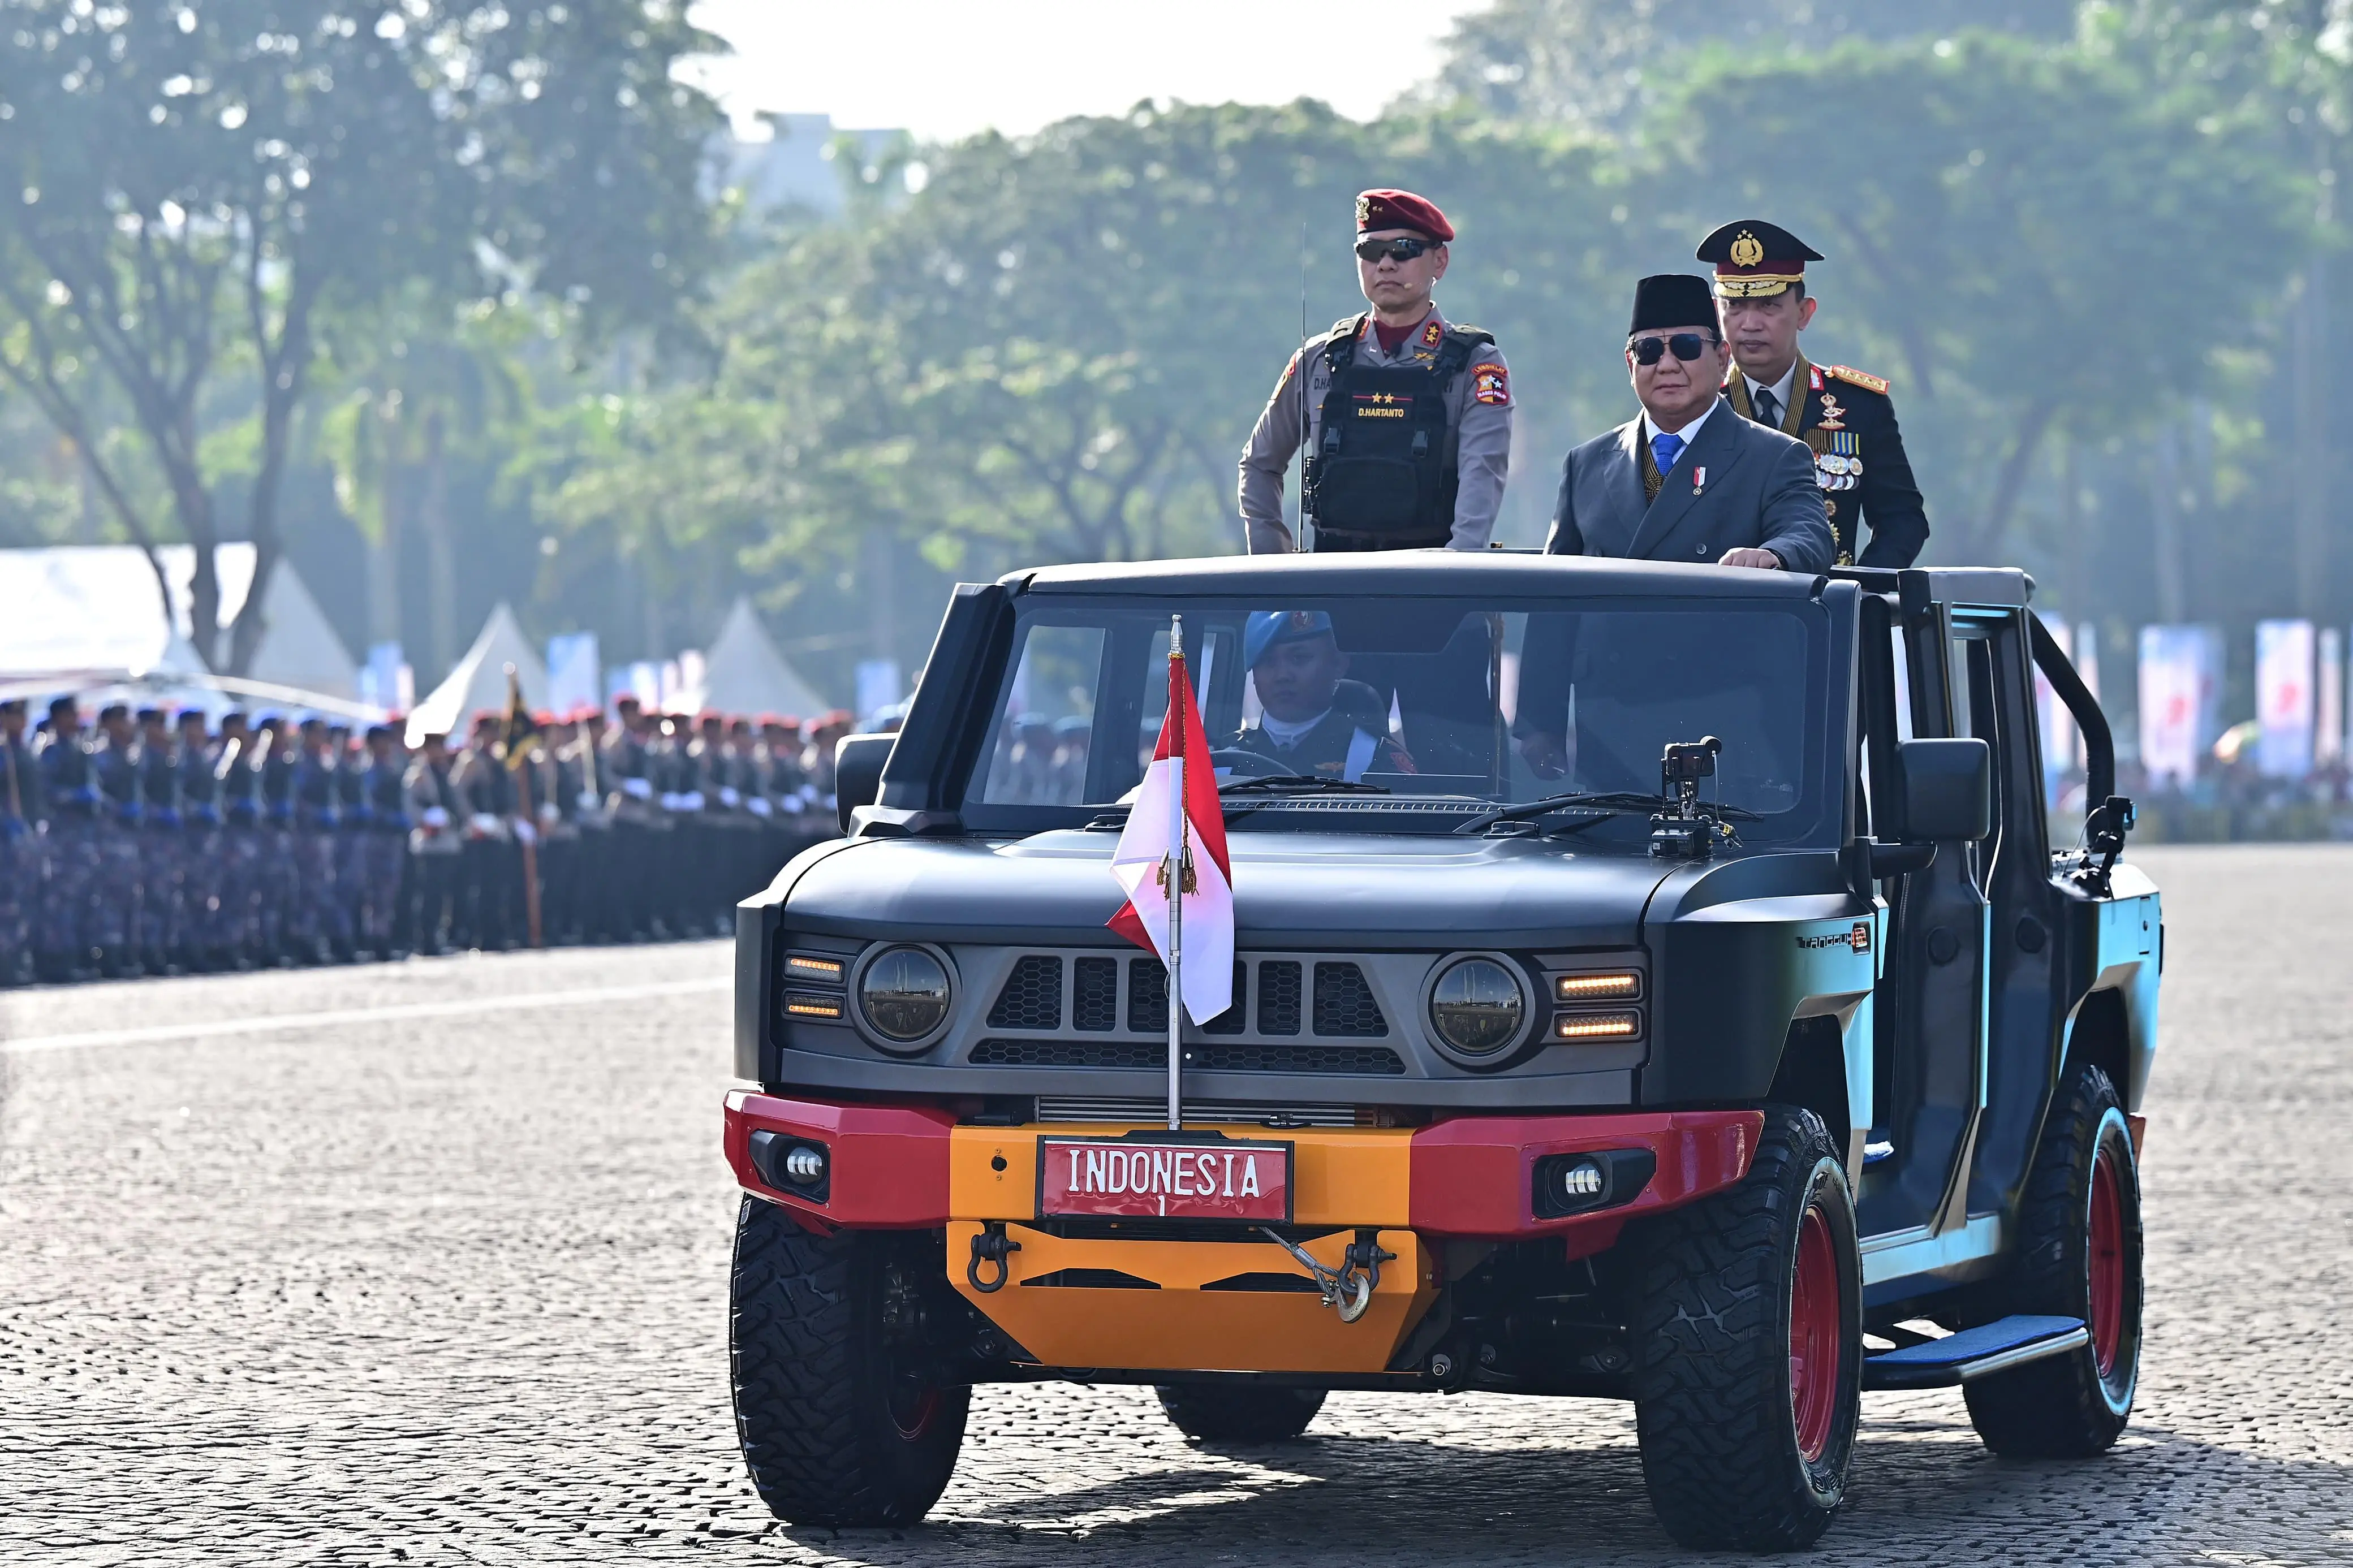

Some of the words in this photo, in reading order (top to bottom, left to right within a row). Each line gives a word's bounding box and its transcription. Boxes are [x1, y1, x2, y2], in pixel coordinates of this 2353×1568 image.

[1358, 408, 1404, 417] D.HARTANTO
[1068, 1149, 1260, 1198] INDONESIA
[1157, 1194, 1166, 1217] 1
